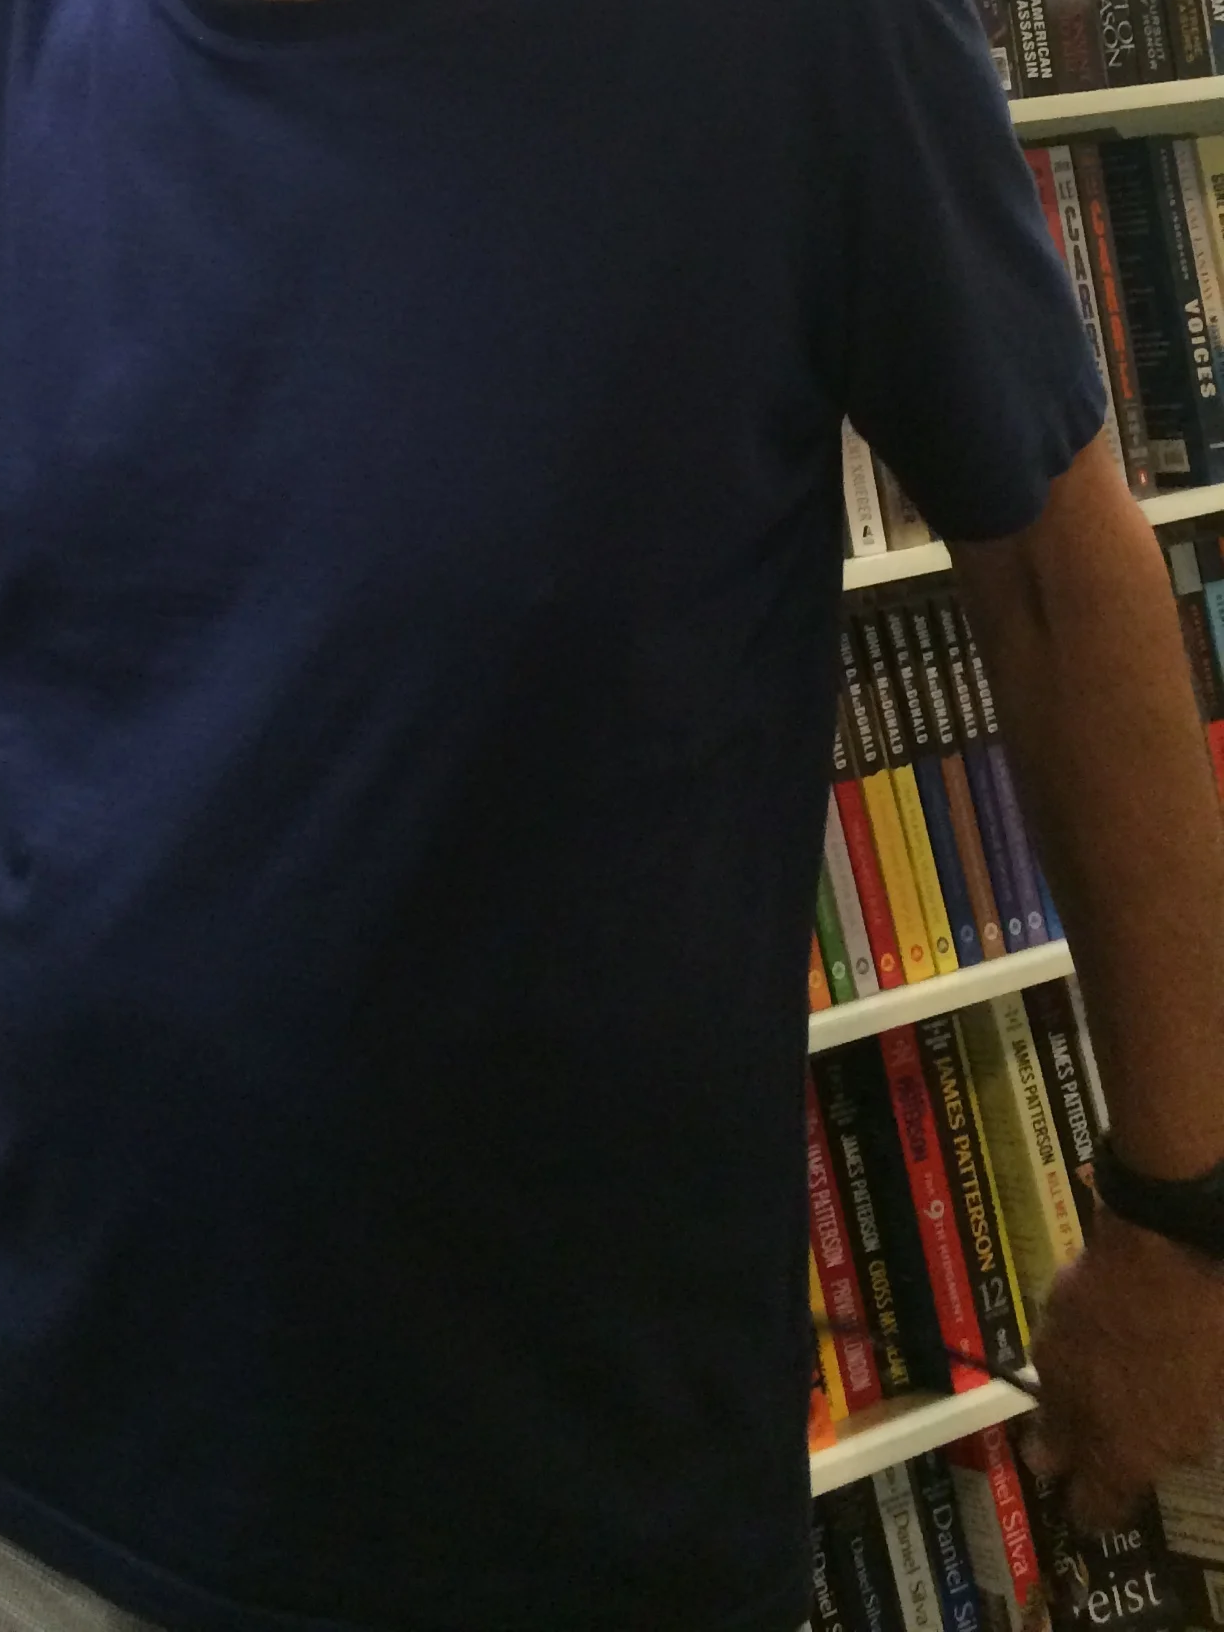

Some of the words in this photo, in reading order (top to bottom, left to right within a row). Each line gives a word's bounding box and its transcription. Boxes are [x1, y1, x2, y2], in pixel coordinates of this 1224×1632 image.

[1016, 0, 1039, 79] ASSASSIN
[1184, 298, 1217, 399] VOICES
[1048, 1032, 1069, 1081] JAMES
[1063, 1083, 1095, 1164] PATTERSON
[935, 1056, 967, 1132] JAMES
[951, 1133, 997, 1274] PATTERSON
[978, 1276, 1008, 1310] 12
[932, 1504, 968, 1596] Daniel
[983, 1428, 1016, 1512] Daniel
[1002, 1511, 1028, 1576] Silva
[1100, 1529, 1142, 1559] The
